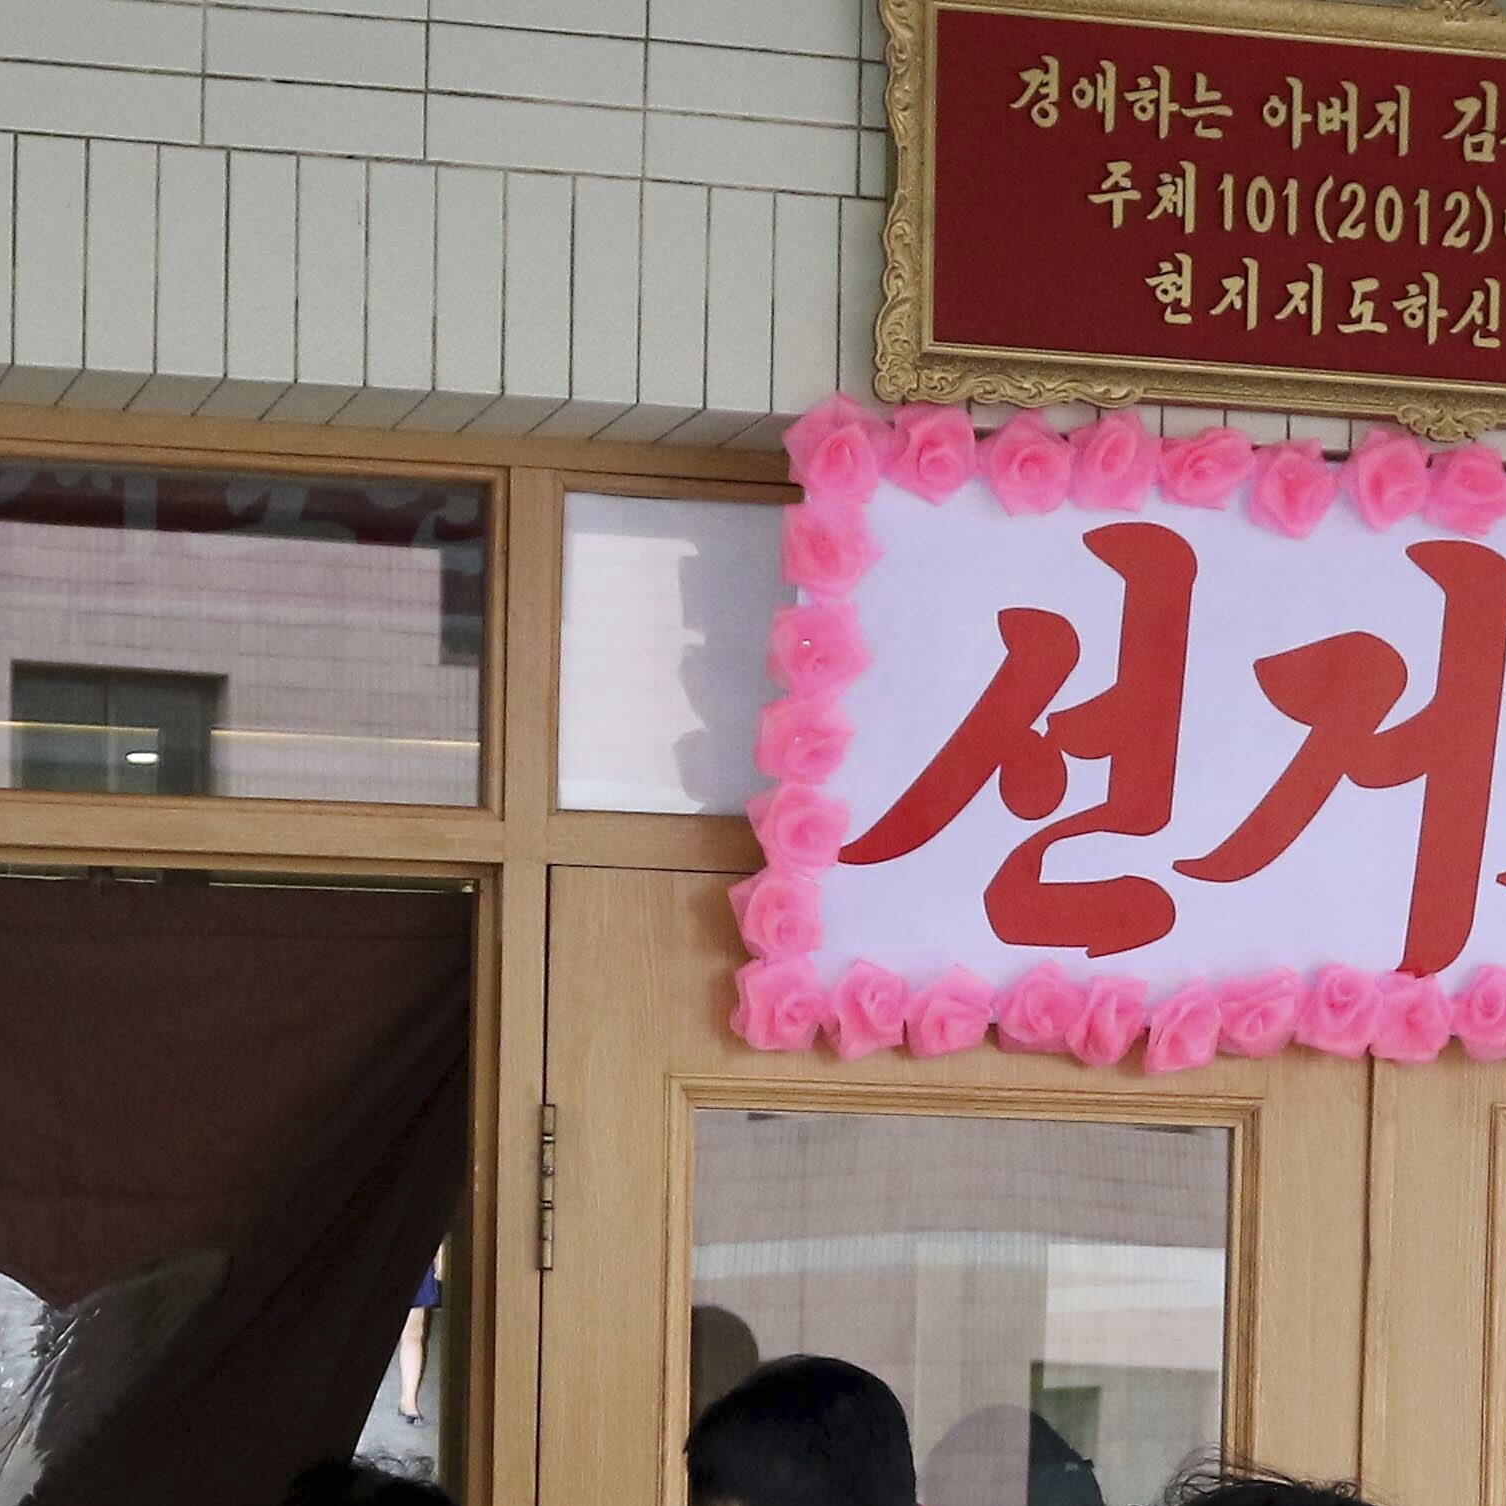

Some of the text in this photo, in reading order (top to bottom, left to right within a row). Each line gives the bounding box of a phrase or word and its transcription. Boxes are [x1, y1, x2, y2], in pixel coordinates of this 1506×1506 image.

[1009, 55, 1235, 141] 경애하는
[1261, 76, 1412, 158] 아버지
[1144, 252, 1503, 350] 현지지도하신
